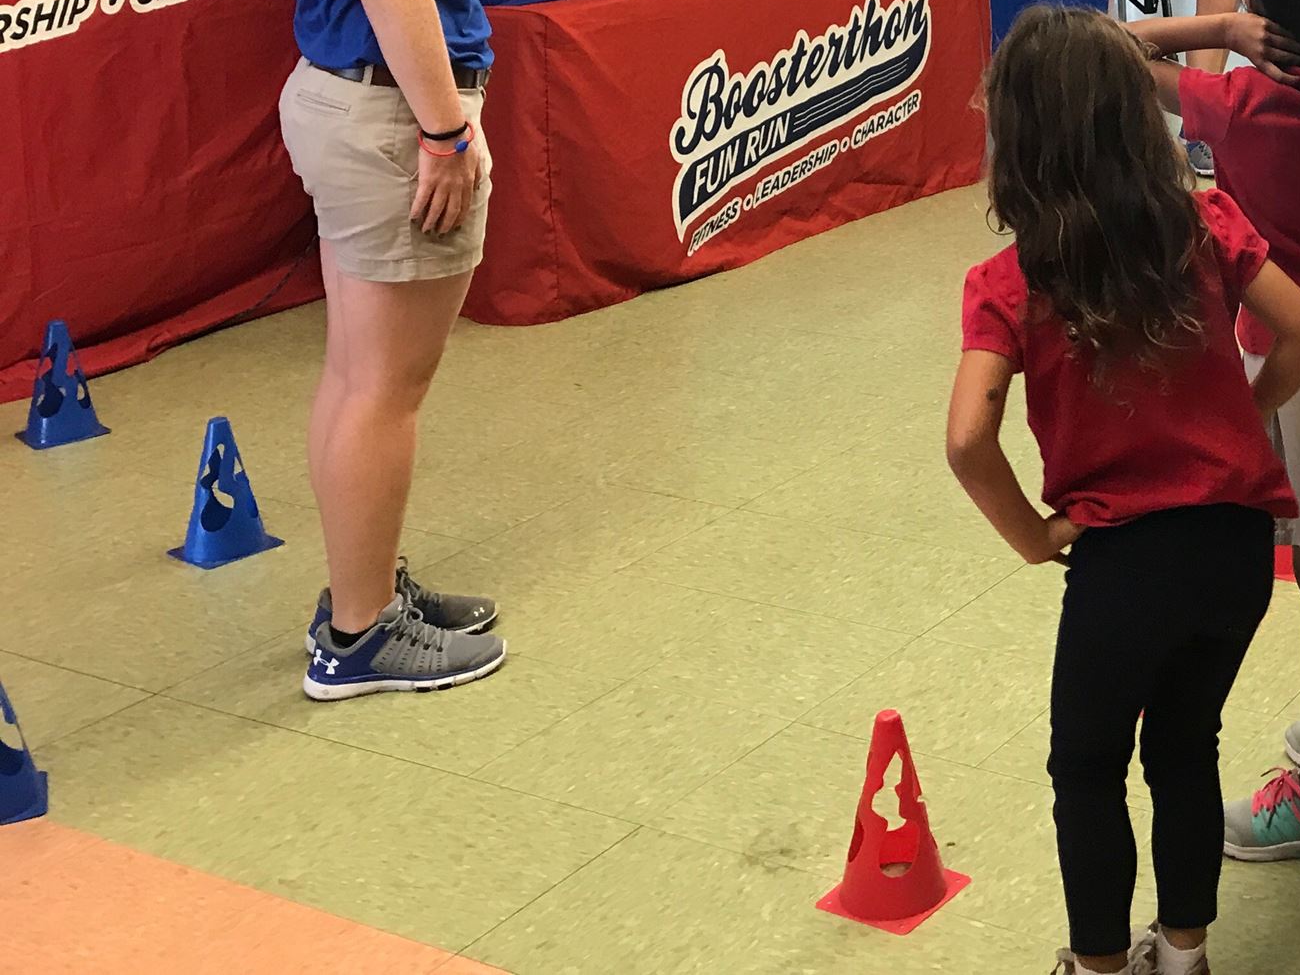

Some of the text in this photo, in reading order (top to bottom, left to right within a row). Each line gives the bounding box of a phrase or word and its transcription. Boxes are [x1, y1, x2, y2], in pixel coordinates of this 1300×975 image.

[690, 93, 920, 251] FITNESS LEADERSHIP CHARACTER
[692, 112, 791, 205] FUN RUN
